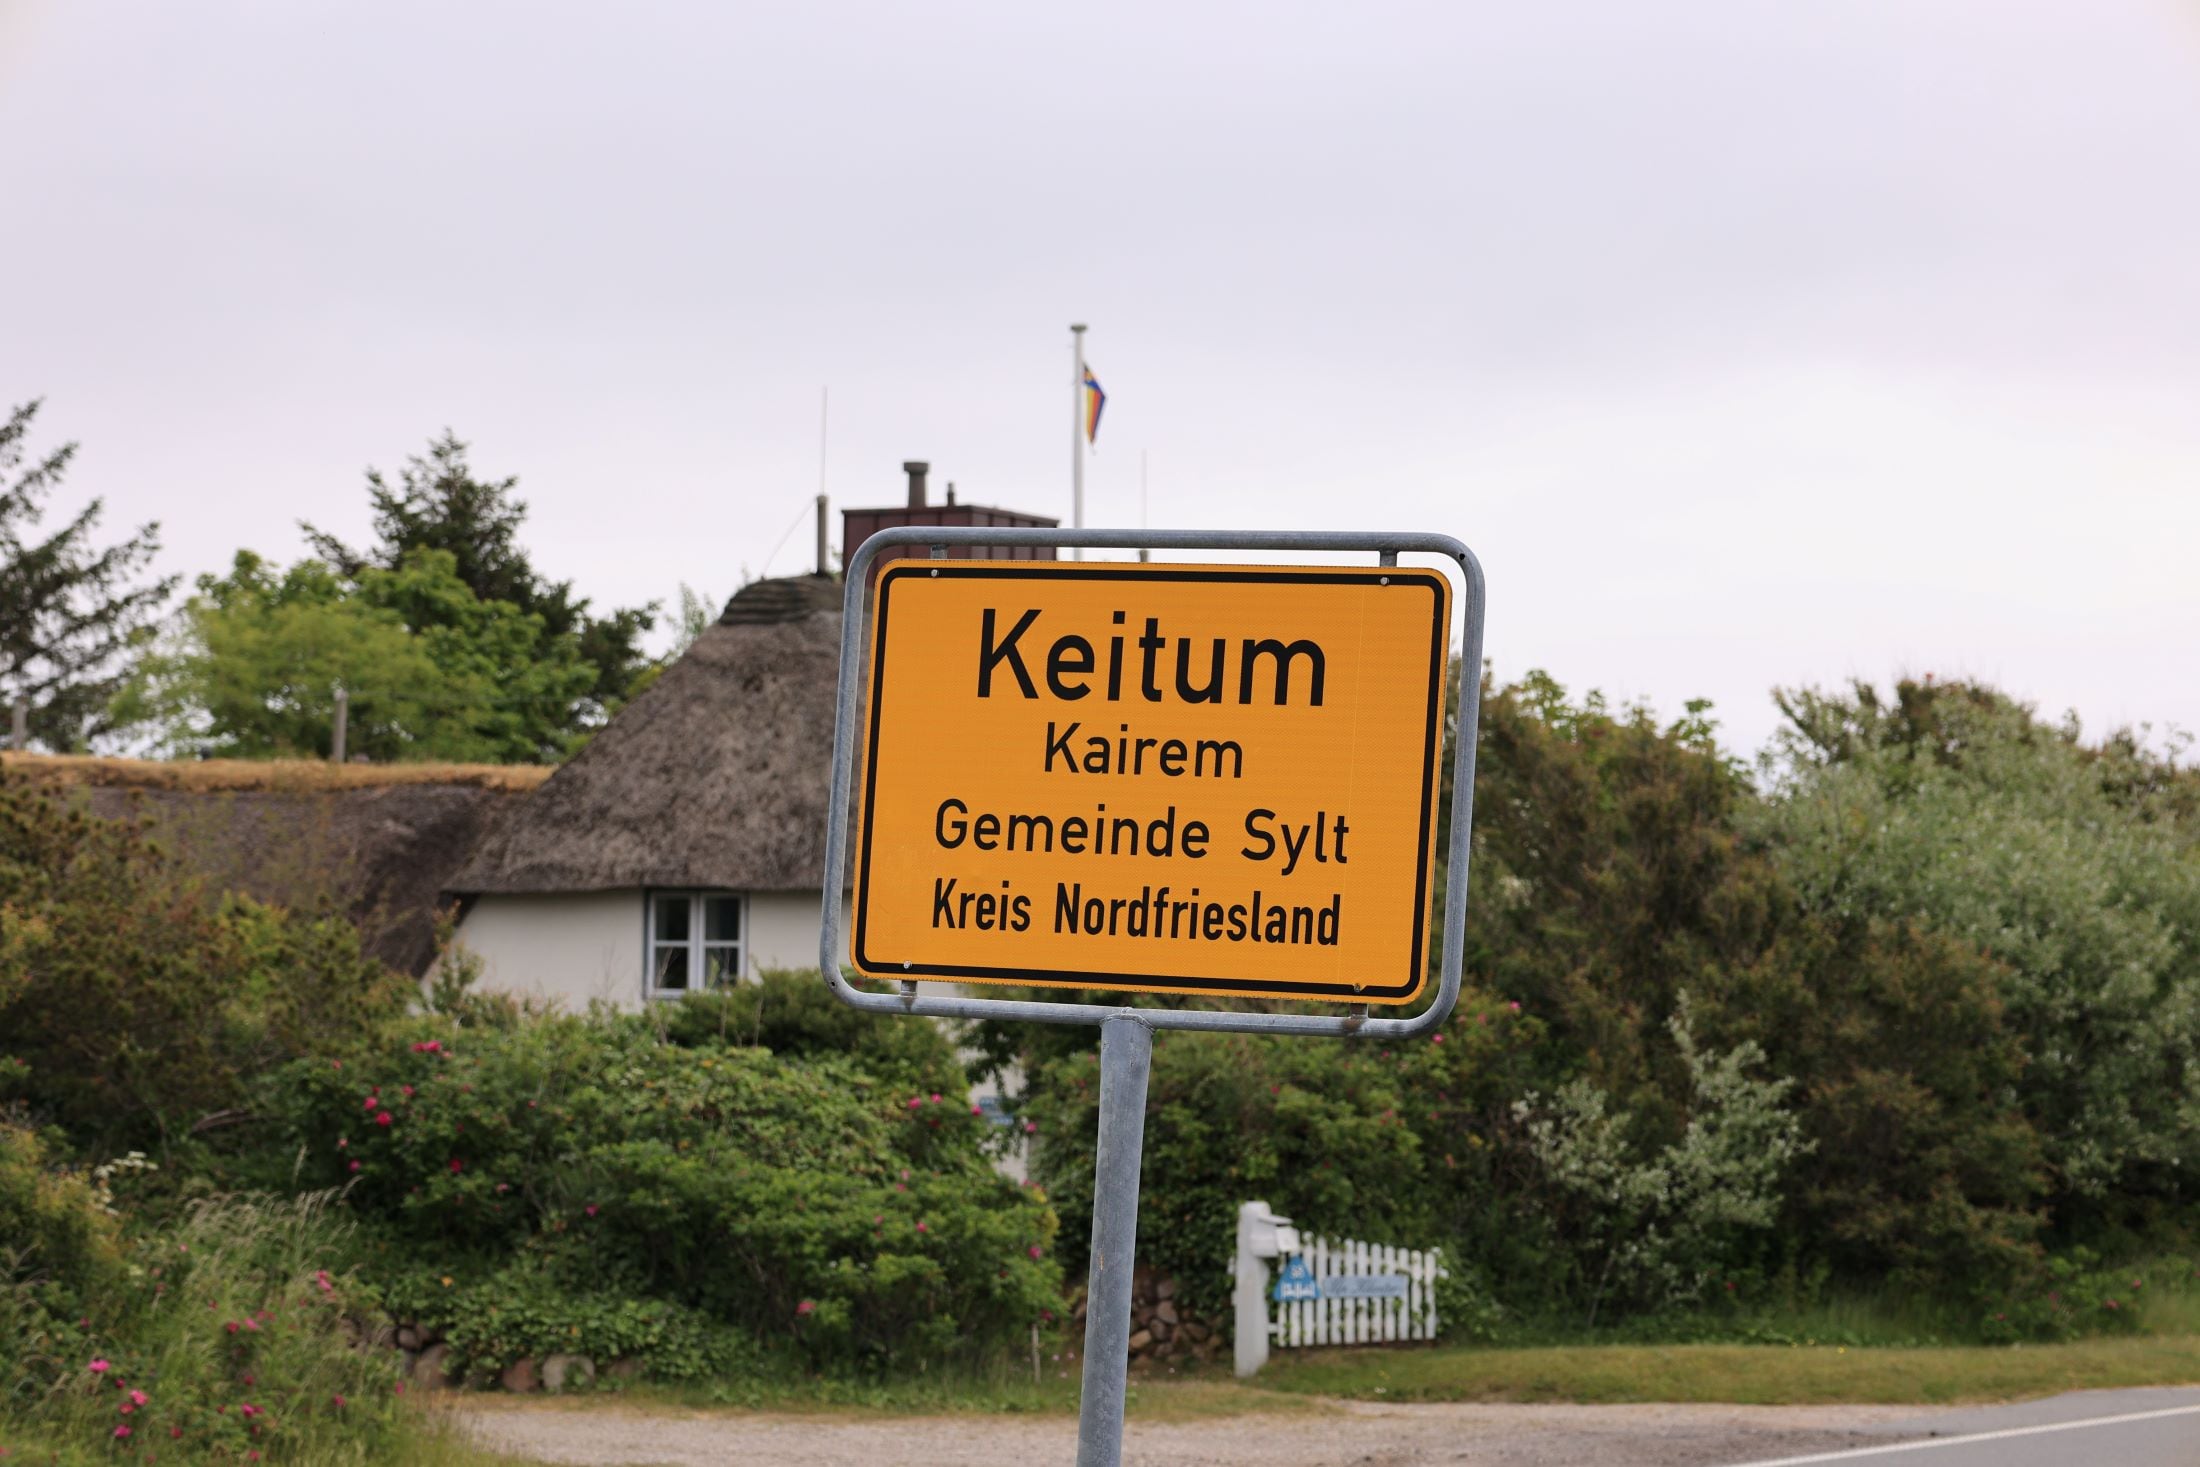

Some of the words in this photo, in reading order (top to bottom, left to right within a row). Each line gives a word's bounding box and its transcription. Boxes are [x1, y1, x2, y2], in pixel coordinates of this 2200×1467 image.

[977, 608, 1326, 707] Keitum
[1044, 721, 1243, 779] Kairem
[935, 798, 1210, 859] Gemeinde
[1240, 808, 1349, 876] Sylt
[932, 877, 1031, 932] Kreis
[1054, 882, 1341, 946] Nordfriesland
